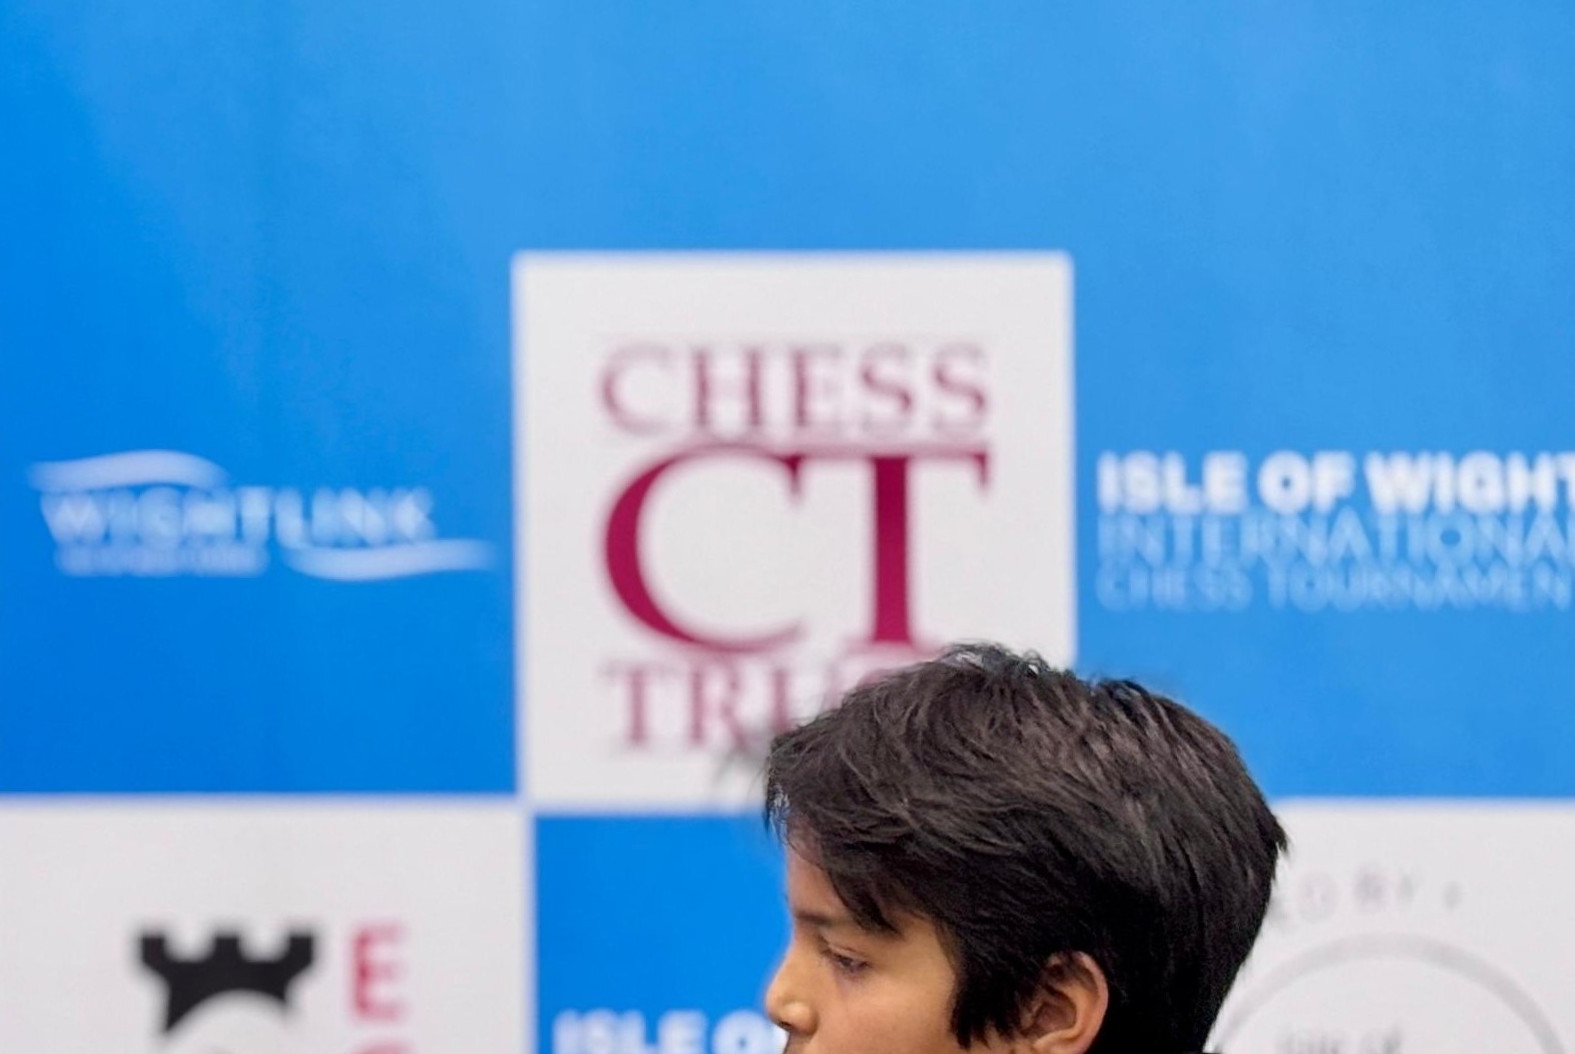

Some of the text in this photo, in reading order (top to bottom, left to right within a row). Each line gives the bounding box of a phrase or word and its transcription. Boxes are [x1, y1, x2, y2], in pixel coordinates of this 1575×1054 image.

[600, 342, 989, 435] CHESS
[1097, 450, 1247, 515] ISLE
[1257, 450, 1356, 515] OF
[602, 441, 989, 655] CT
[1097, 509, 1575, 568] INTERNATIONA
[1096, 562, 1575, 611] CHESS TOURNAMEN
